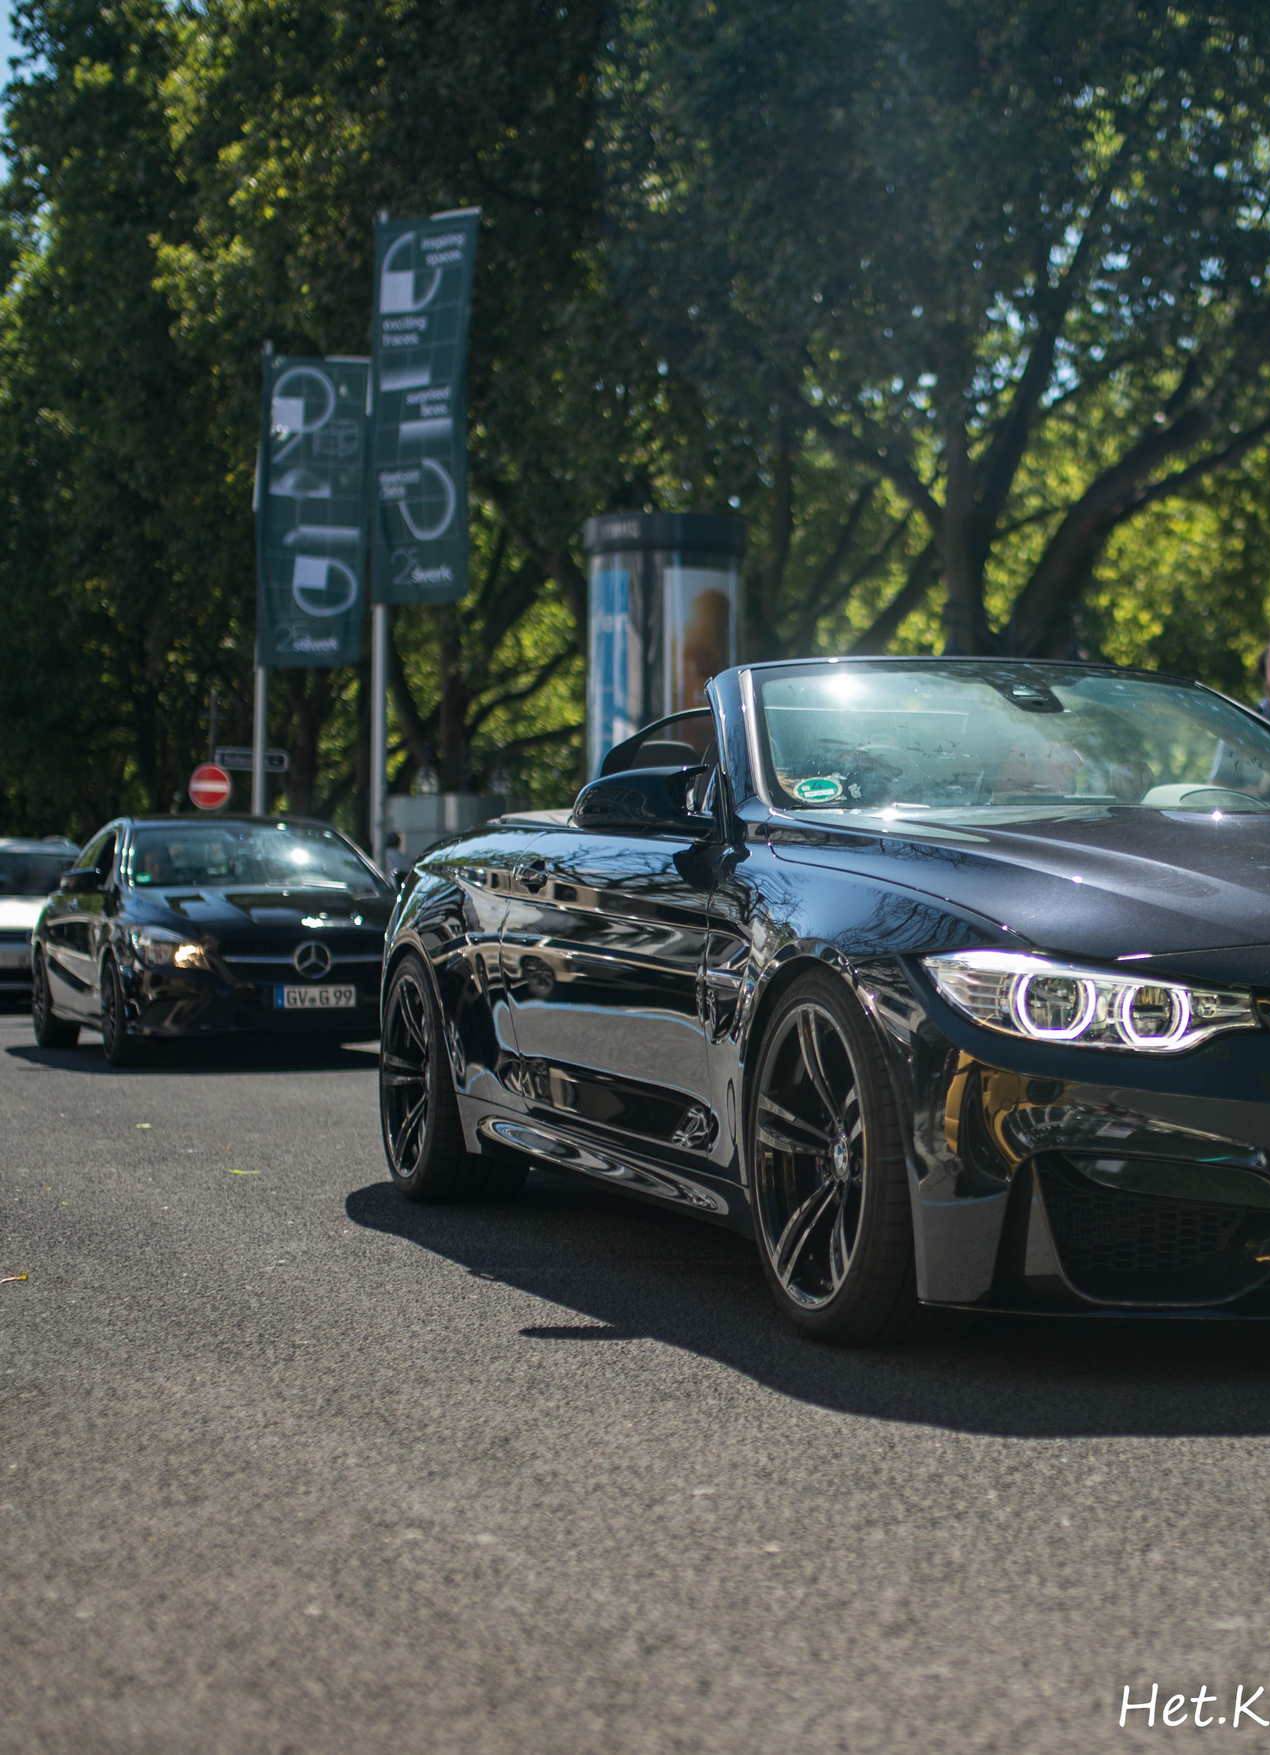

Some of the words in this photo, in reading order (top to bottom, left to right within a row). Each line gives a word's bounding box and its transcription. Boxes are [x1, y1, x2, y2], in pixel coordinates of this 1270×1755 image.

[382, 316, 428, 332] exciting
[286, 989, 307, 1007] GV
[319, 989, 330, 1006] G
[333, 988, 353, 1006] 99
